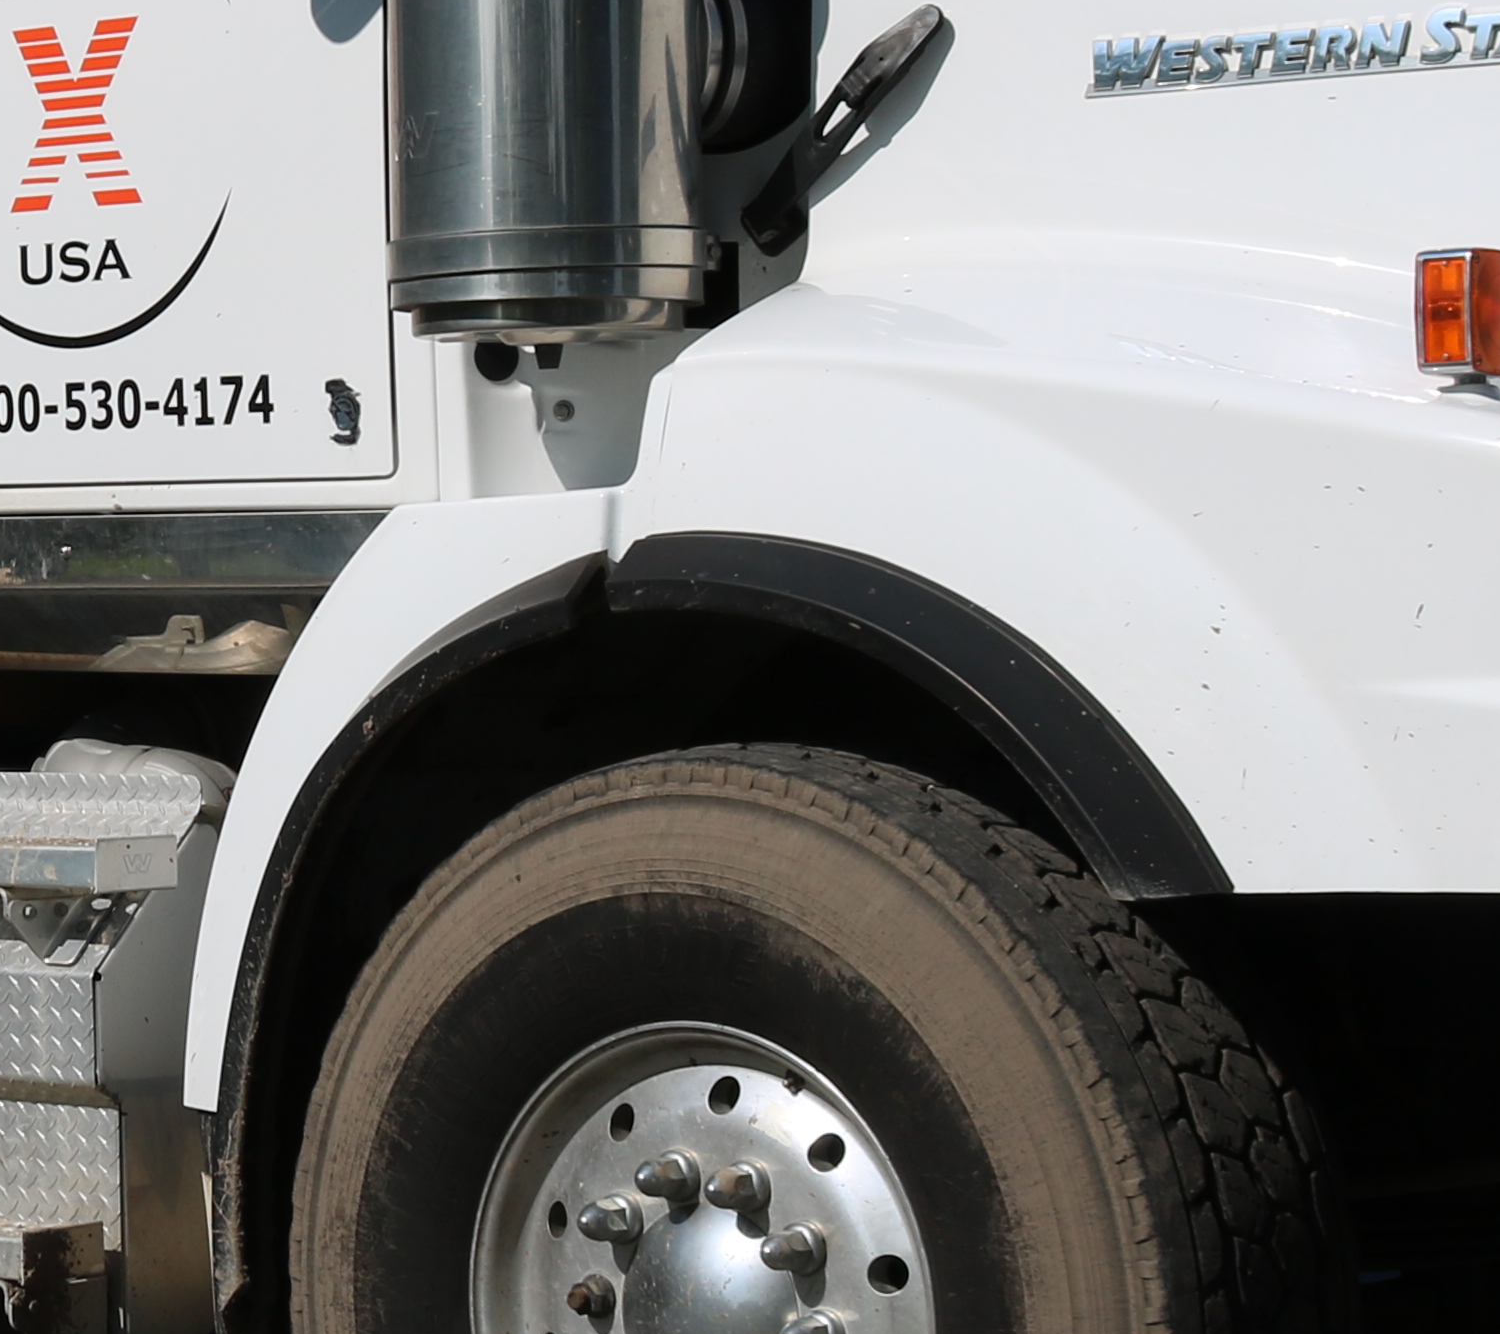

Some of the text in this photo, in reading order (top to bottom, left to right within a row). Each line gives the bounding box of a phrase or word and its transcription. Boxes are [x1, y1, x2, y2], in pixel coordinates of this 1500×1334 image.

[1092, 20, 1411, 91] WESTERN
[11, 15, 142, 213] X
[19, 239, 132, 286] USA
